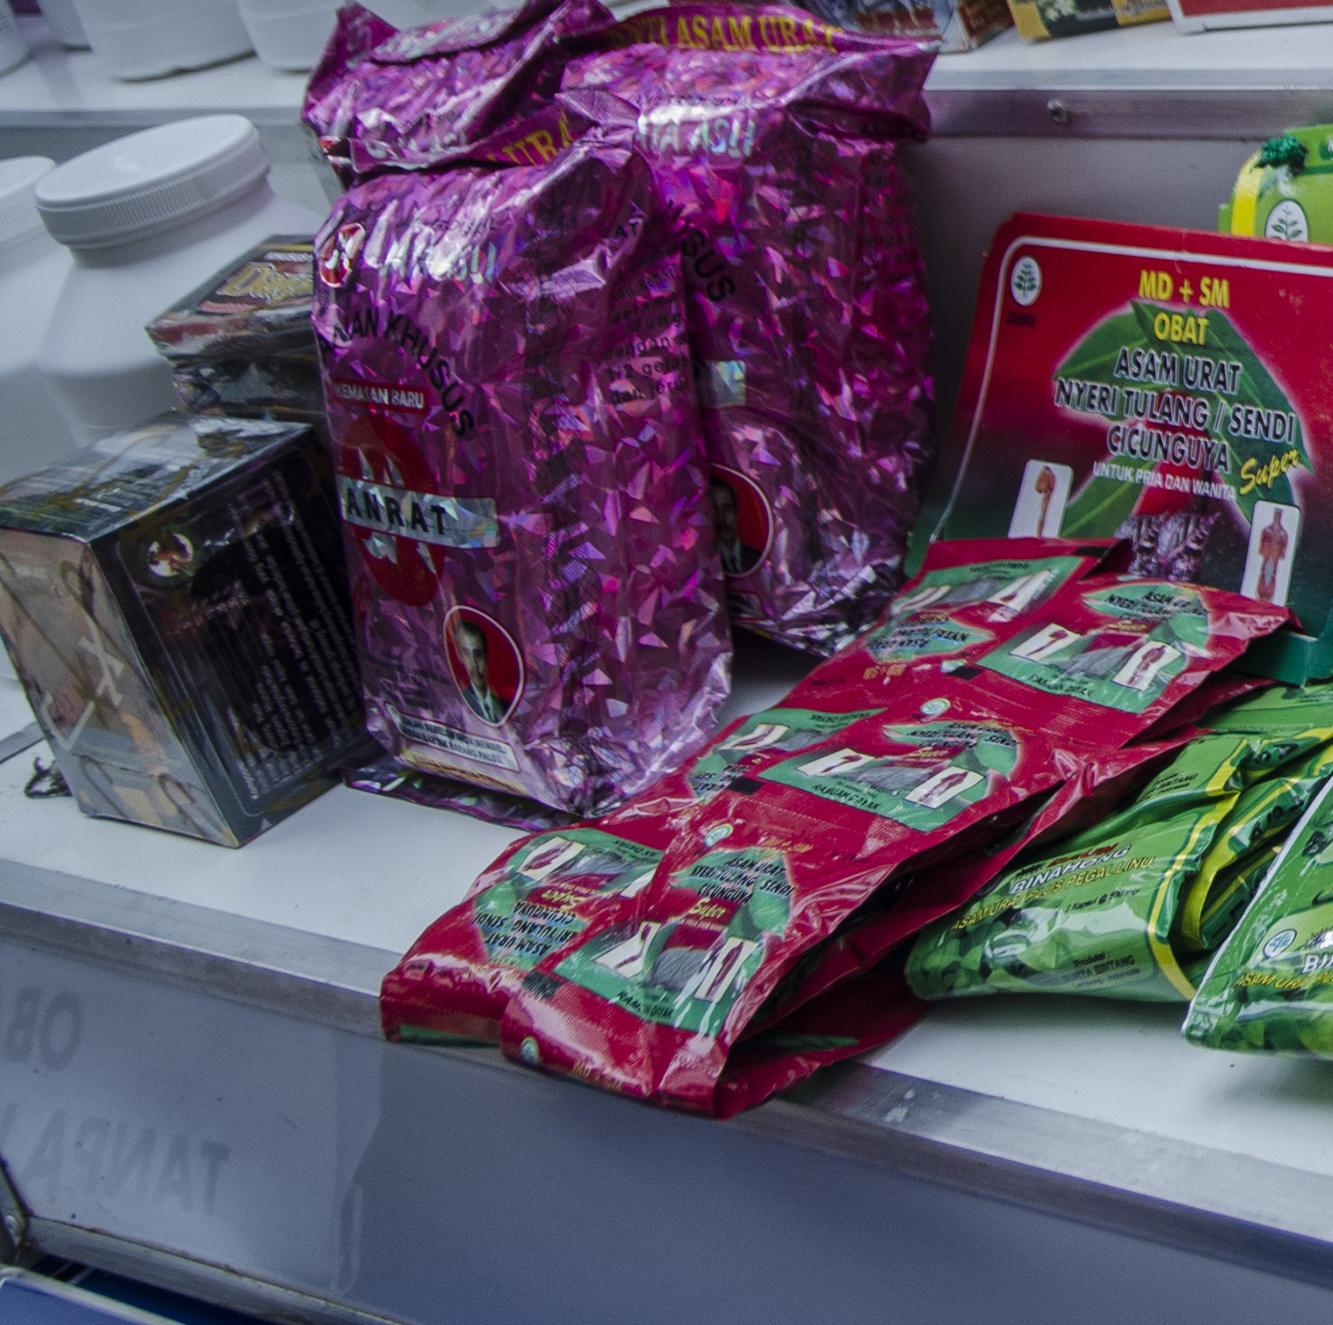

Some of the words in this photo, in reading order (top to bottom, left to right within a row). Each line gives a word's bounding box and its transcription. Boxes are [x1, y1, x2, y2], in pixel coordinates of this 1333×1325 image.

[1137, 269, 1174, 302] MD
[1177, 280, 1194, 305] +
[1197, 276, 1232, 309] SM
[1151, 311, 1211, 347] OBAT
[1112, 346, 1181, 389] ASAM
[1181, 357, 1243, 395] URAT
[1105, 424, 1231, 476] CICUNGUYA
[1008, 843, 1133, 897] BINAHONG
